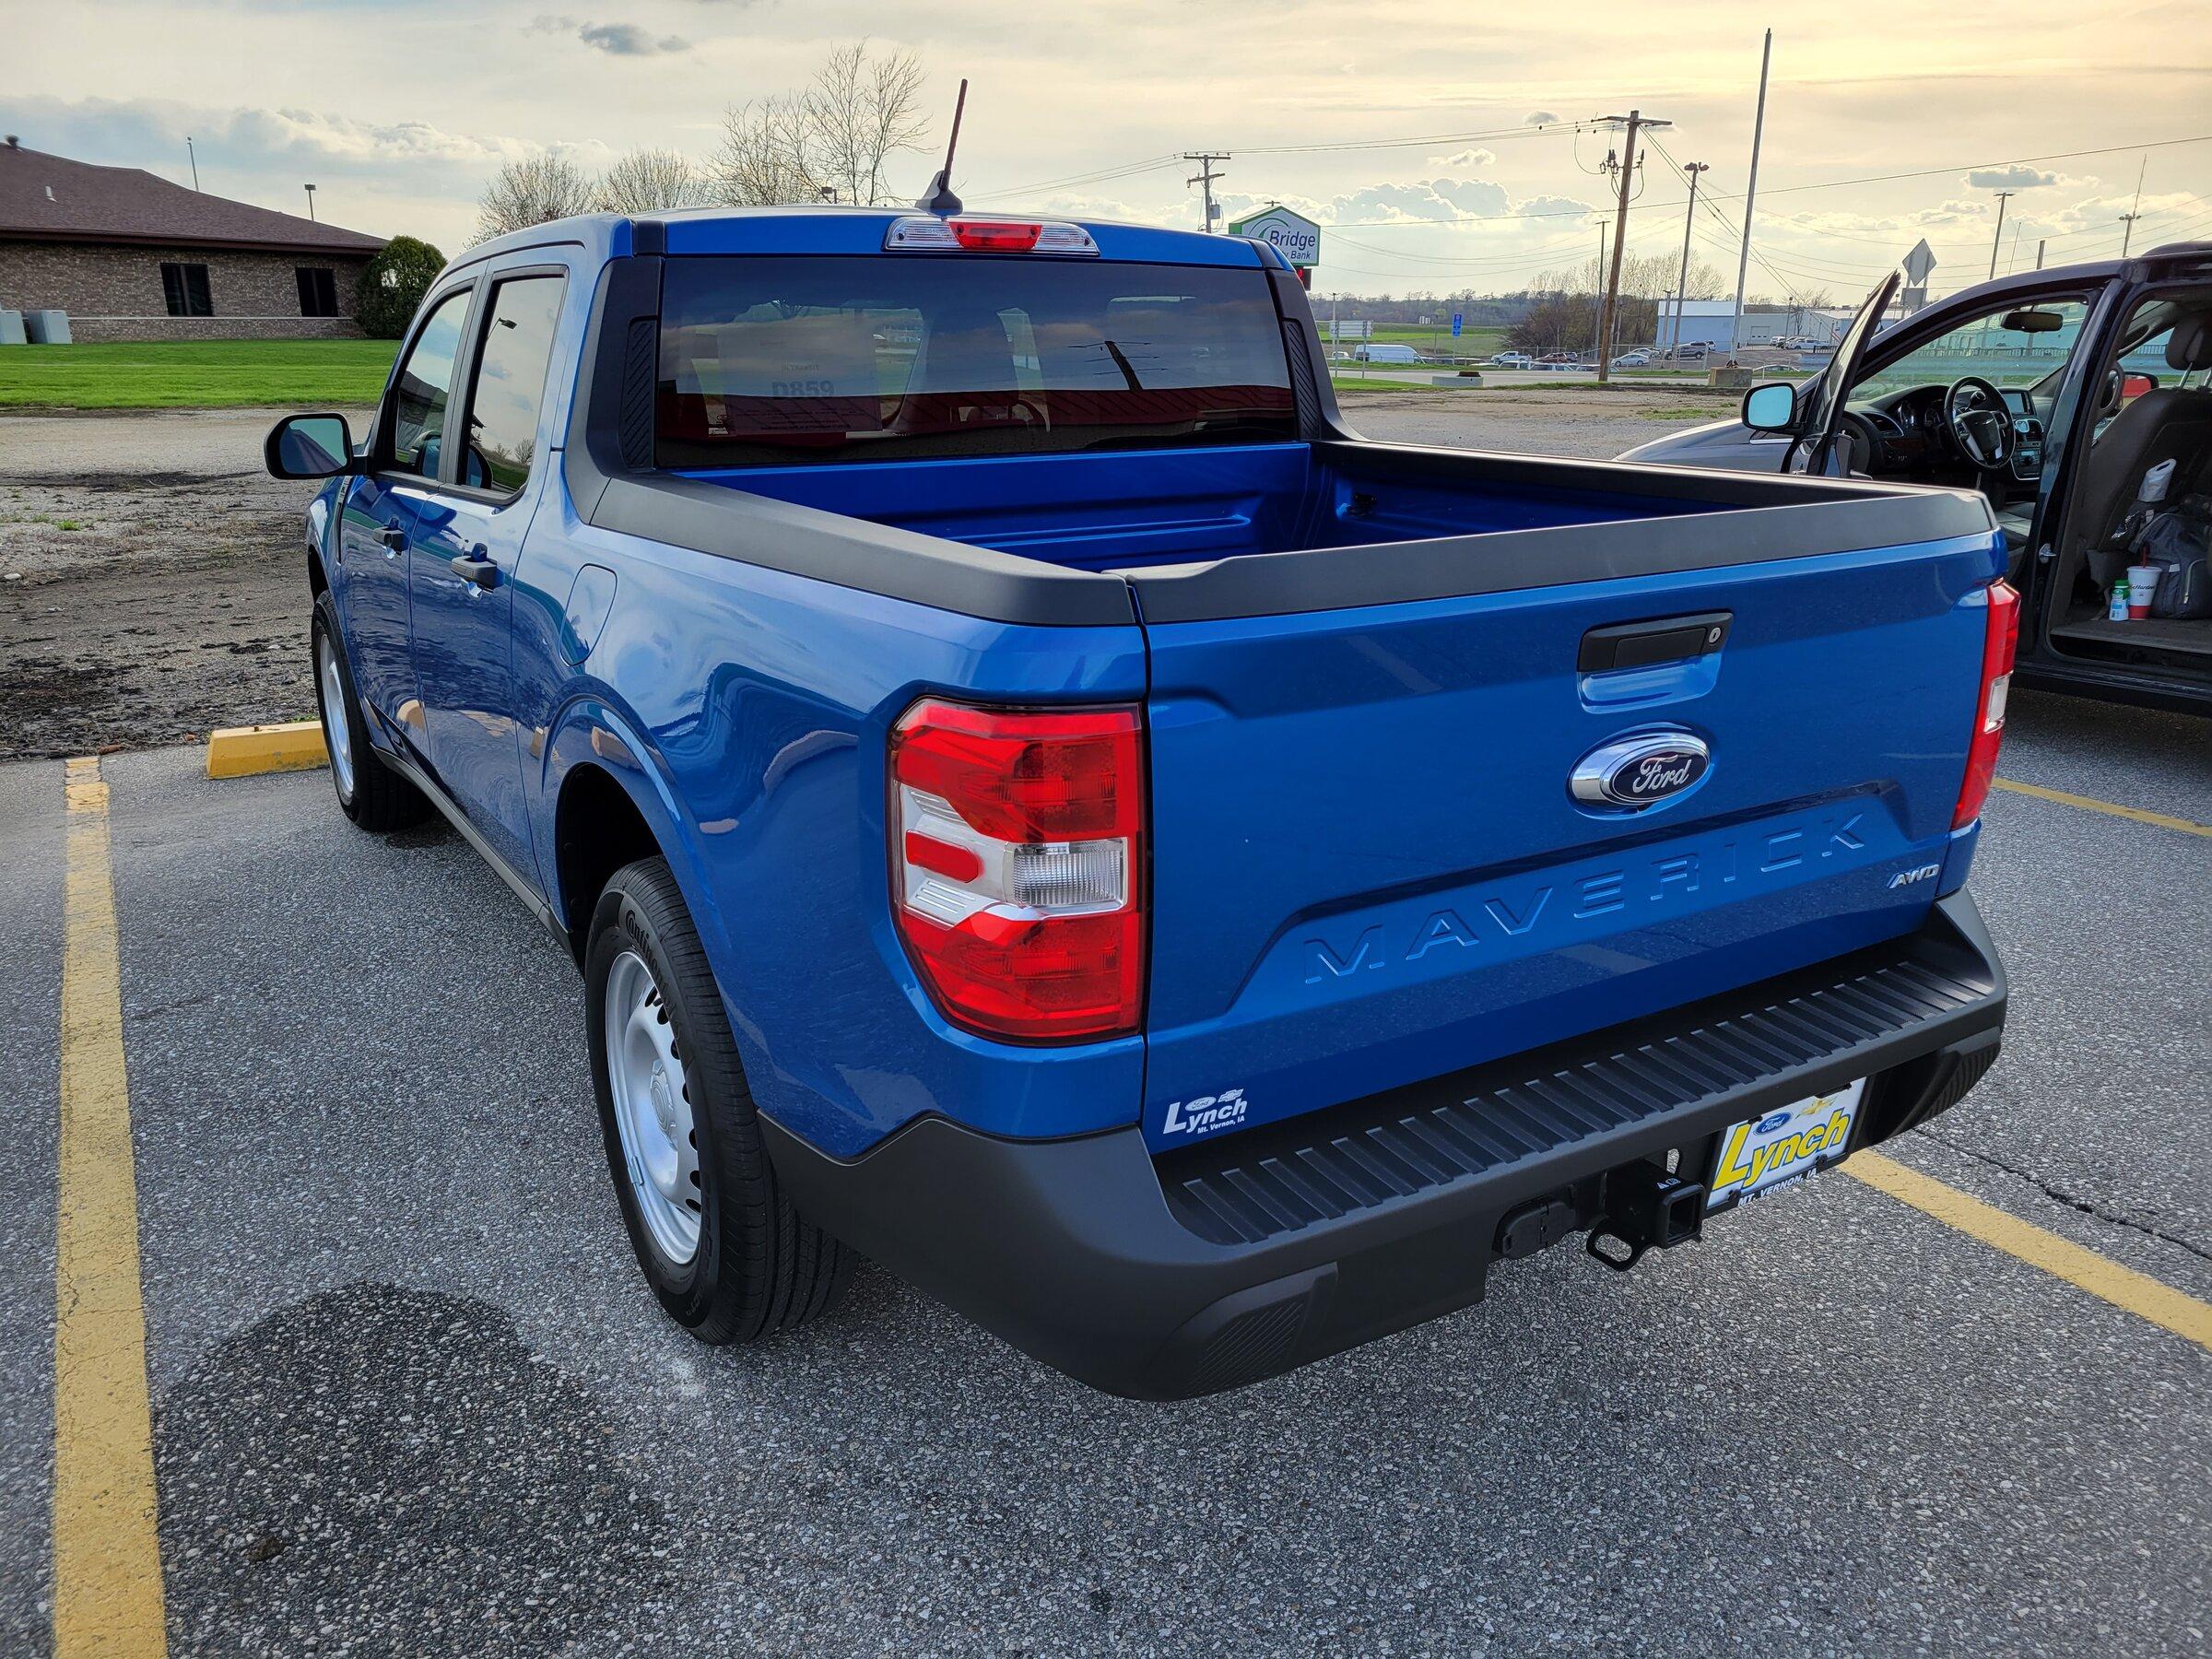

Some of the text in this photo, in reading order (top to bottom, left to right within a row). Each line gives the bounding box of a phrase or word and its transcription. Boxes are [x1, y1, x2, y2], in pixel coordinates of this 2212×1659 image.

[1269, 229, 1316, 251] Bridge
[1290, 250, 1312, 260] Bank
[1632, 754, 1692, 794] Ford
[1886, 864, 1940, 889] AWD
[1304, 813, 1865, 984] MAVERICK
[1162, 1098, 1248, 1135] Lynch
[1197, 1115, 1245, 1135] Mt. Vernon, IA
[1761, 1116, 1784, 1133] Ford
[1711, 1107, 1851, 1192] Lynch
[1737, 1168, 1818, 1206] MT. VERNON, IA
